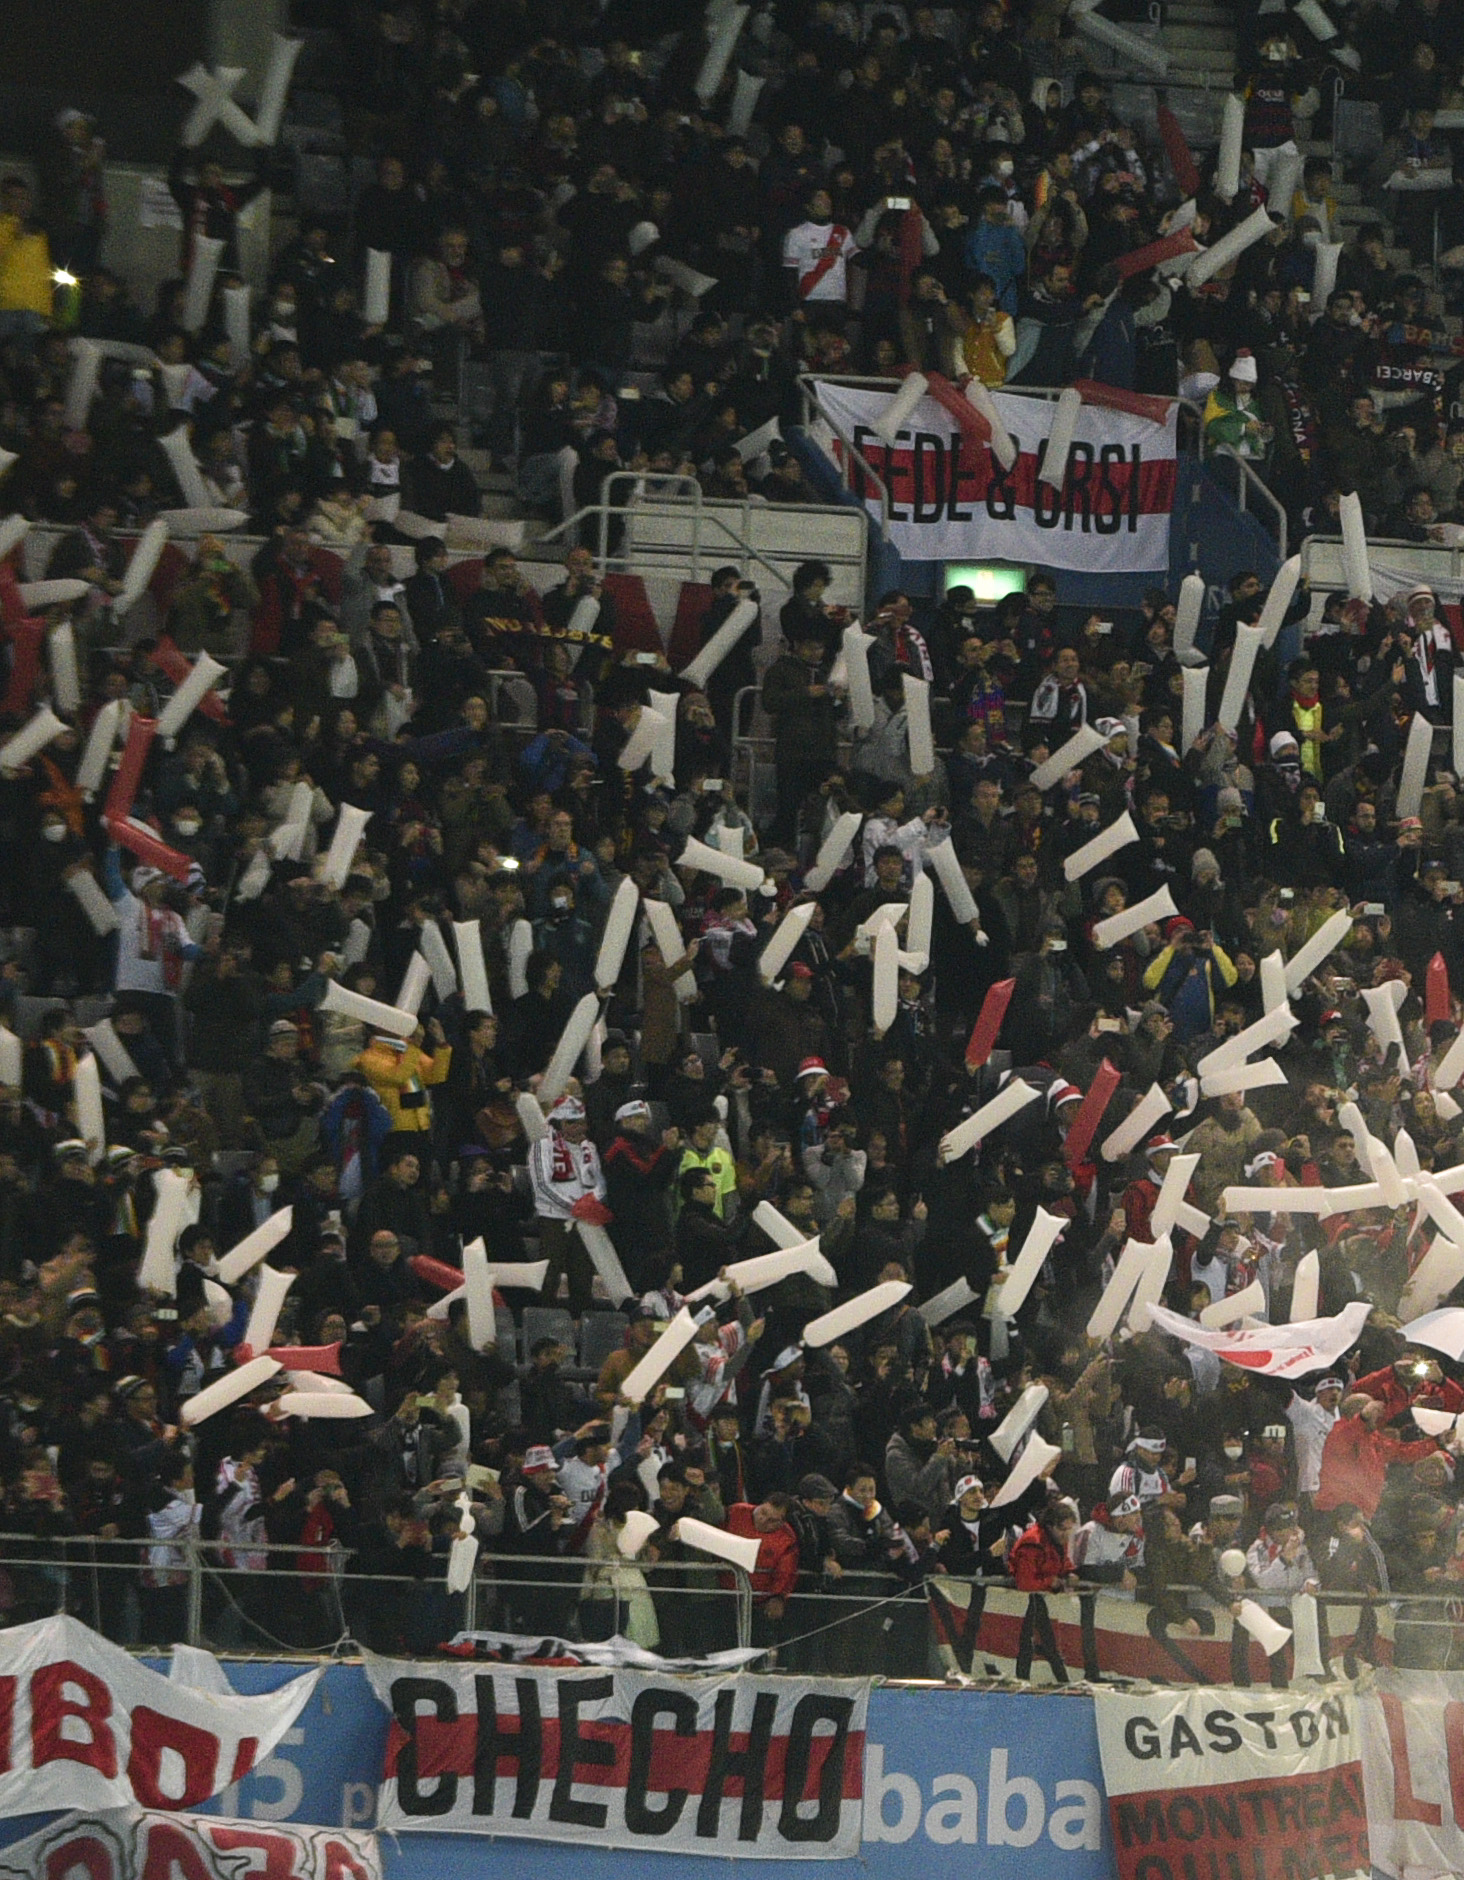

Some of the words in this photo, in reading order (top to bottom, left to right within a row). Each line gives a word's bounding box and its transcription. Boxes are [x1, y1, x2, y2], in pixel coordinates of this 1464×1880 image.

[0, 1660, 258, 1811] BO
[390, 1674, 860, 1845] CHECHO
[1124, 1696, 1350, 1760] GASTON
[863, 1742, 1100, 1851] baba
